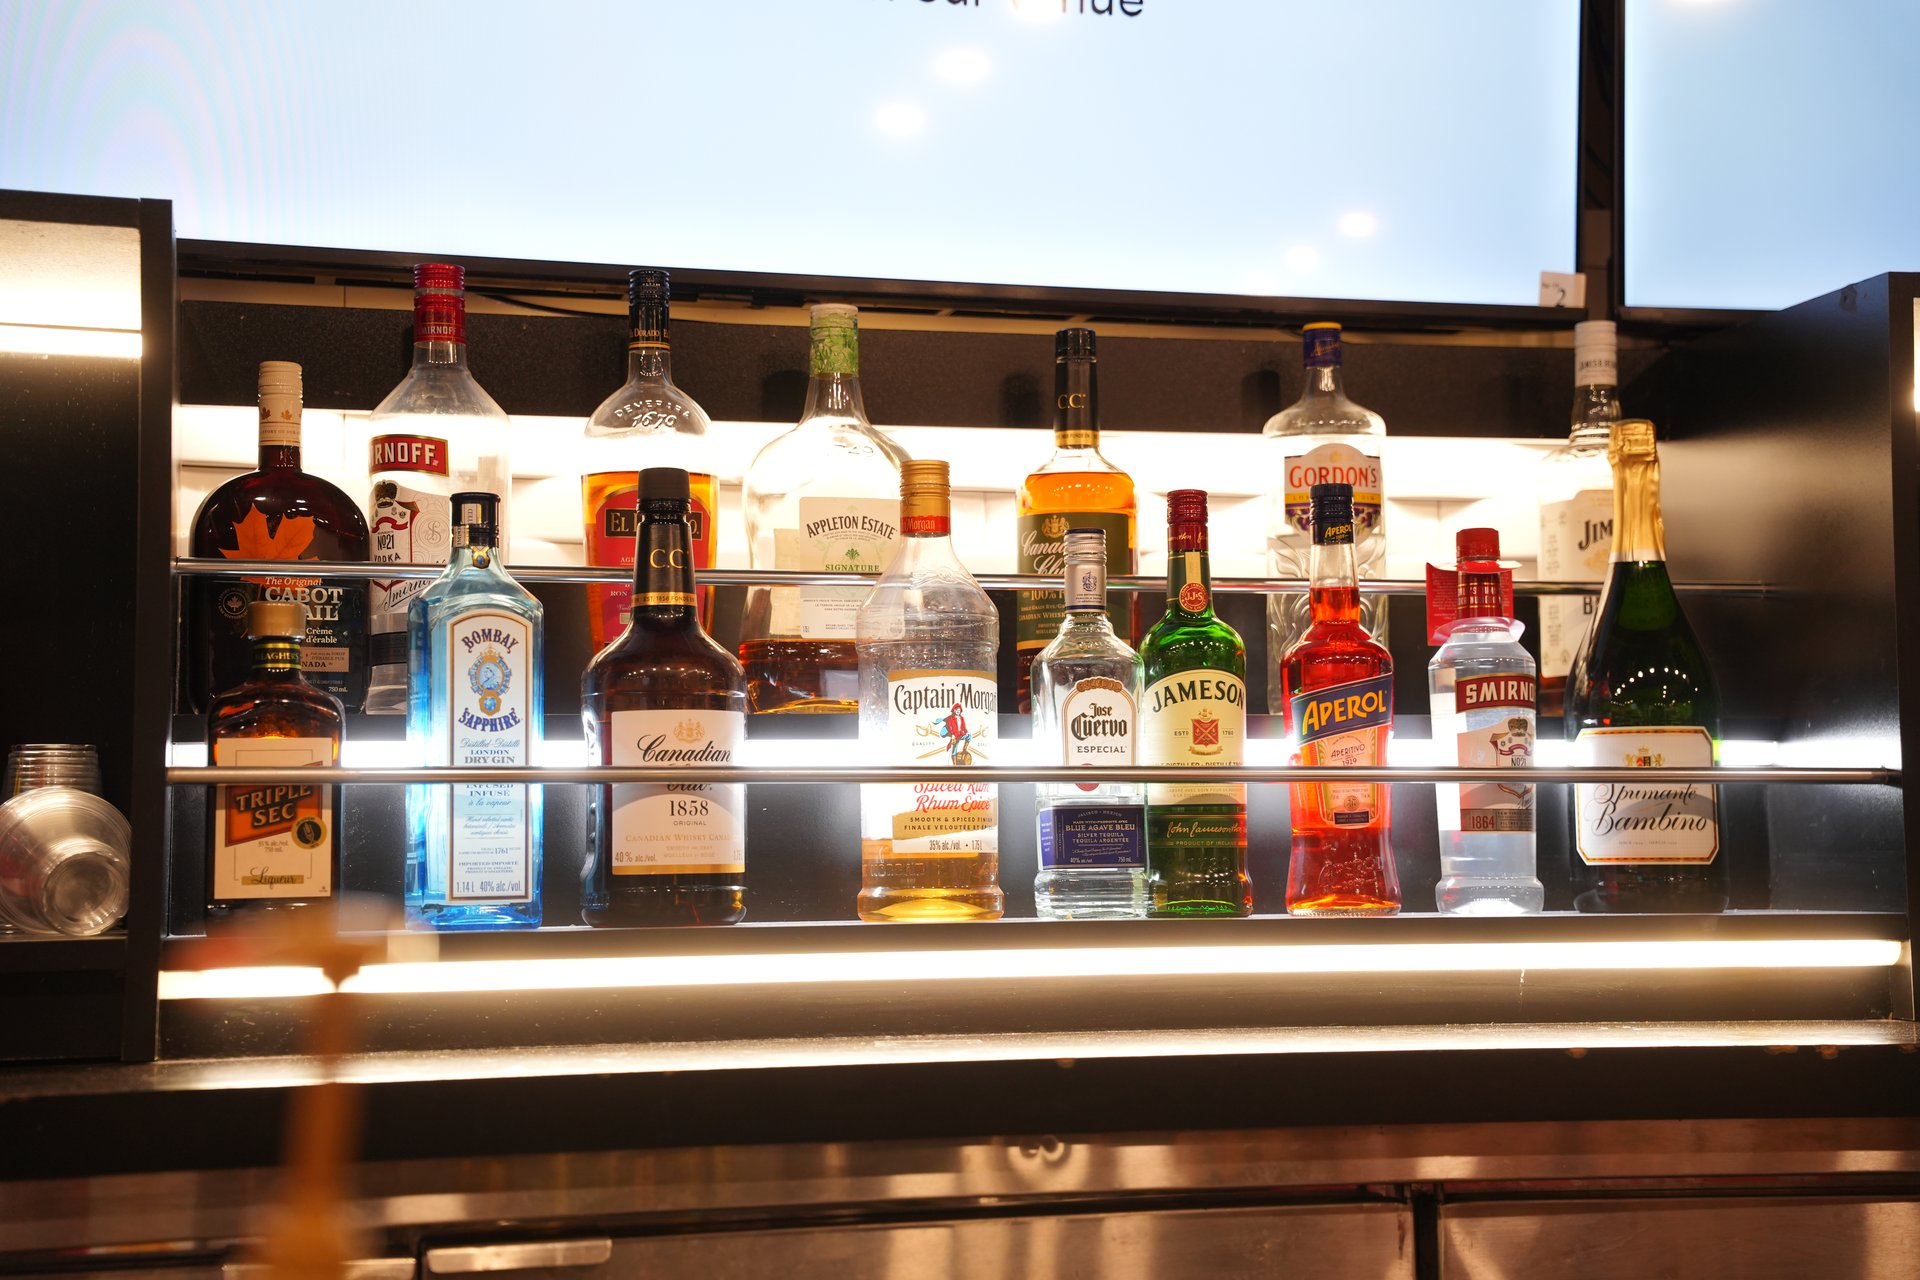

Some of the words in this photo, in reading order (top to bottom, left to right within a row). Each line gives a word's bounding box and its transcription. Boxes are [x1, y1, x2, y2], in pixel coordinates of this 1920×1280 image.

[420, 325, 457, 335] MIRNOFF
[634, 328, 660, 338] DORADO
[370, 442, 437, 466] IRNOFF
[1289, 465, 1377, 489] GORDON'S
[806, 515, 860, 539] APPLETON
[861, 515, 897, 541] ESTATE
[908, 519, 935, 532] Morgan
[1324, 524, 1352, 537] APEROL
[1021, 530, 1066, 556] Cana
[1578, 519, 1613, 551] JIM
[374, 553, 401, 563] VODKA
[649, 548, 688, 569] C.C.
[825, 564, 880, 572] SIGNATURE
[265, 576, 282, 586] The
[284, 577, 322, 587] Original
[265, 587, 343, 604] CABOT
[306, 605, 340, 621] AIL
[305, 635, 338, 644] d'érable
[306, 627, 333, 635] Crème
[461, 628, 519, 654] BOMBAY
[893, 683, 955, 715] Captain
[1152, 680, 1245, 713] JAMESON
[1465, 680, 1535, 704] SMIRNO
[1089, 702, 1113, 719] Jose
[1302, 689, 1387, 736] APEROL
[458, 707, 521, 733] SAPPHIRE
[1071, 712, 1128, 741] Cuervo
[637, 734, 733, 763] Canadian
[1077, 745, 1126, 753] ESPECIAL
[1331, 744, 1366, 759] APERITIVO
[464, 756, 489, 764] DRY
[491, 756, 515, 764] GIN
[236, 784, 311, 811] TRIPLE
[915, 794, 960, 813] Rhum
[1594, 784, 1697, 806] Spumante
[253, 803, 295, 826] SEC
[669, 799, 710, 817] 1858
[1471, 815, 1495, 830] 1864
[1588, 800, 1708, 837] Bambino
[1065, 824, 1087, 832] BLUE
[1115, 823, 1136, 831] BLEU
[1167, 821, 1189, 838] John
[626, 834, 670, 842] CANADIAN
[673, 833, 706, 841] WHISKY
[928, 840, 941, 850] 35%
[495, 847, 509, 855] 1761
[456, 881, 470, 893] 1.14
[480, 880, 494, 893] 40%
